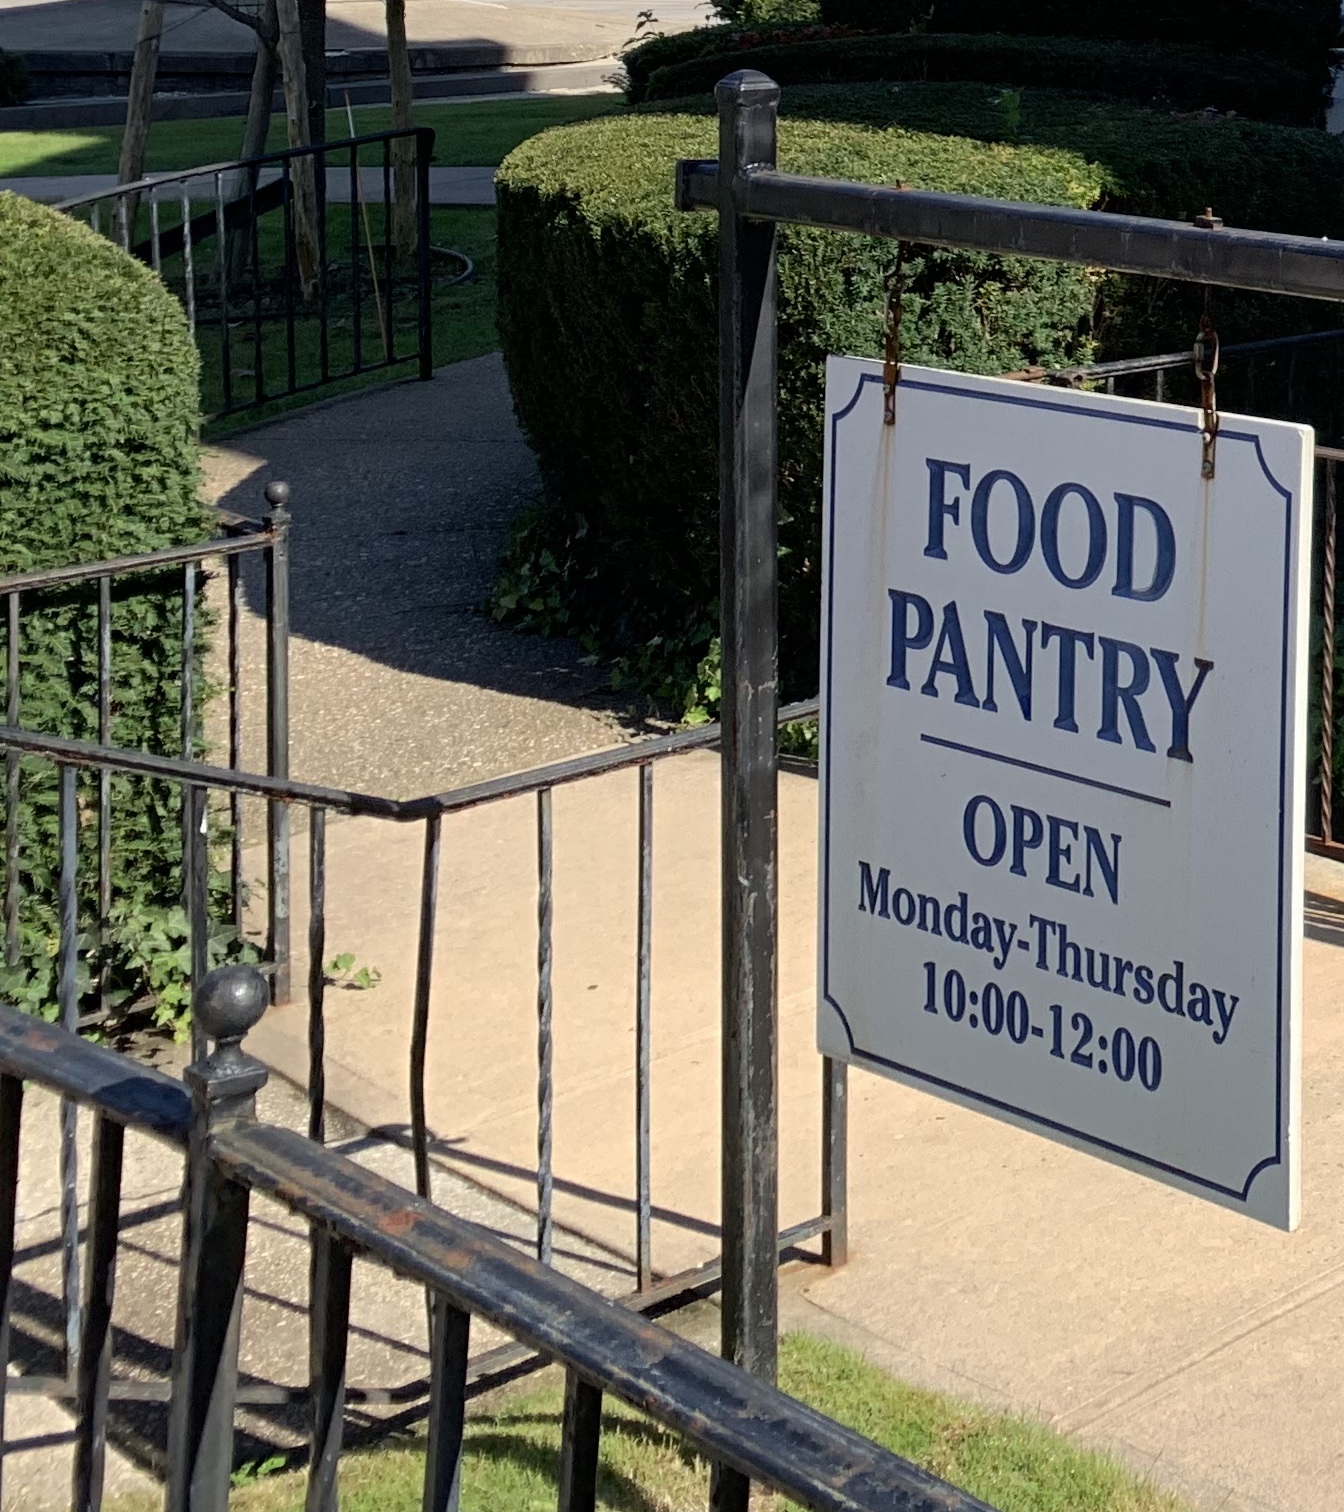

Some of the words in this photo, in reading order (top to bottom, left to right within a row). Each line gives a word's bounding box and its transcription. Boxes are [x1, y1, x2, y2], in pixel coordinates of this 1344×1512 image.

[923, 457, 1177, 603] FOOD
[886, 588, 1215, 763] PANTRY
[963, 794, 1122, 905] OPEN
[857, 860, 1240, 1045] Monday-Thursday
[922, 960, 1163, 1092] 10:00-12:00
